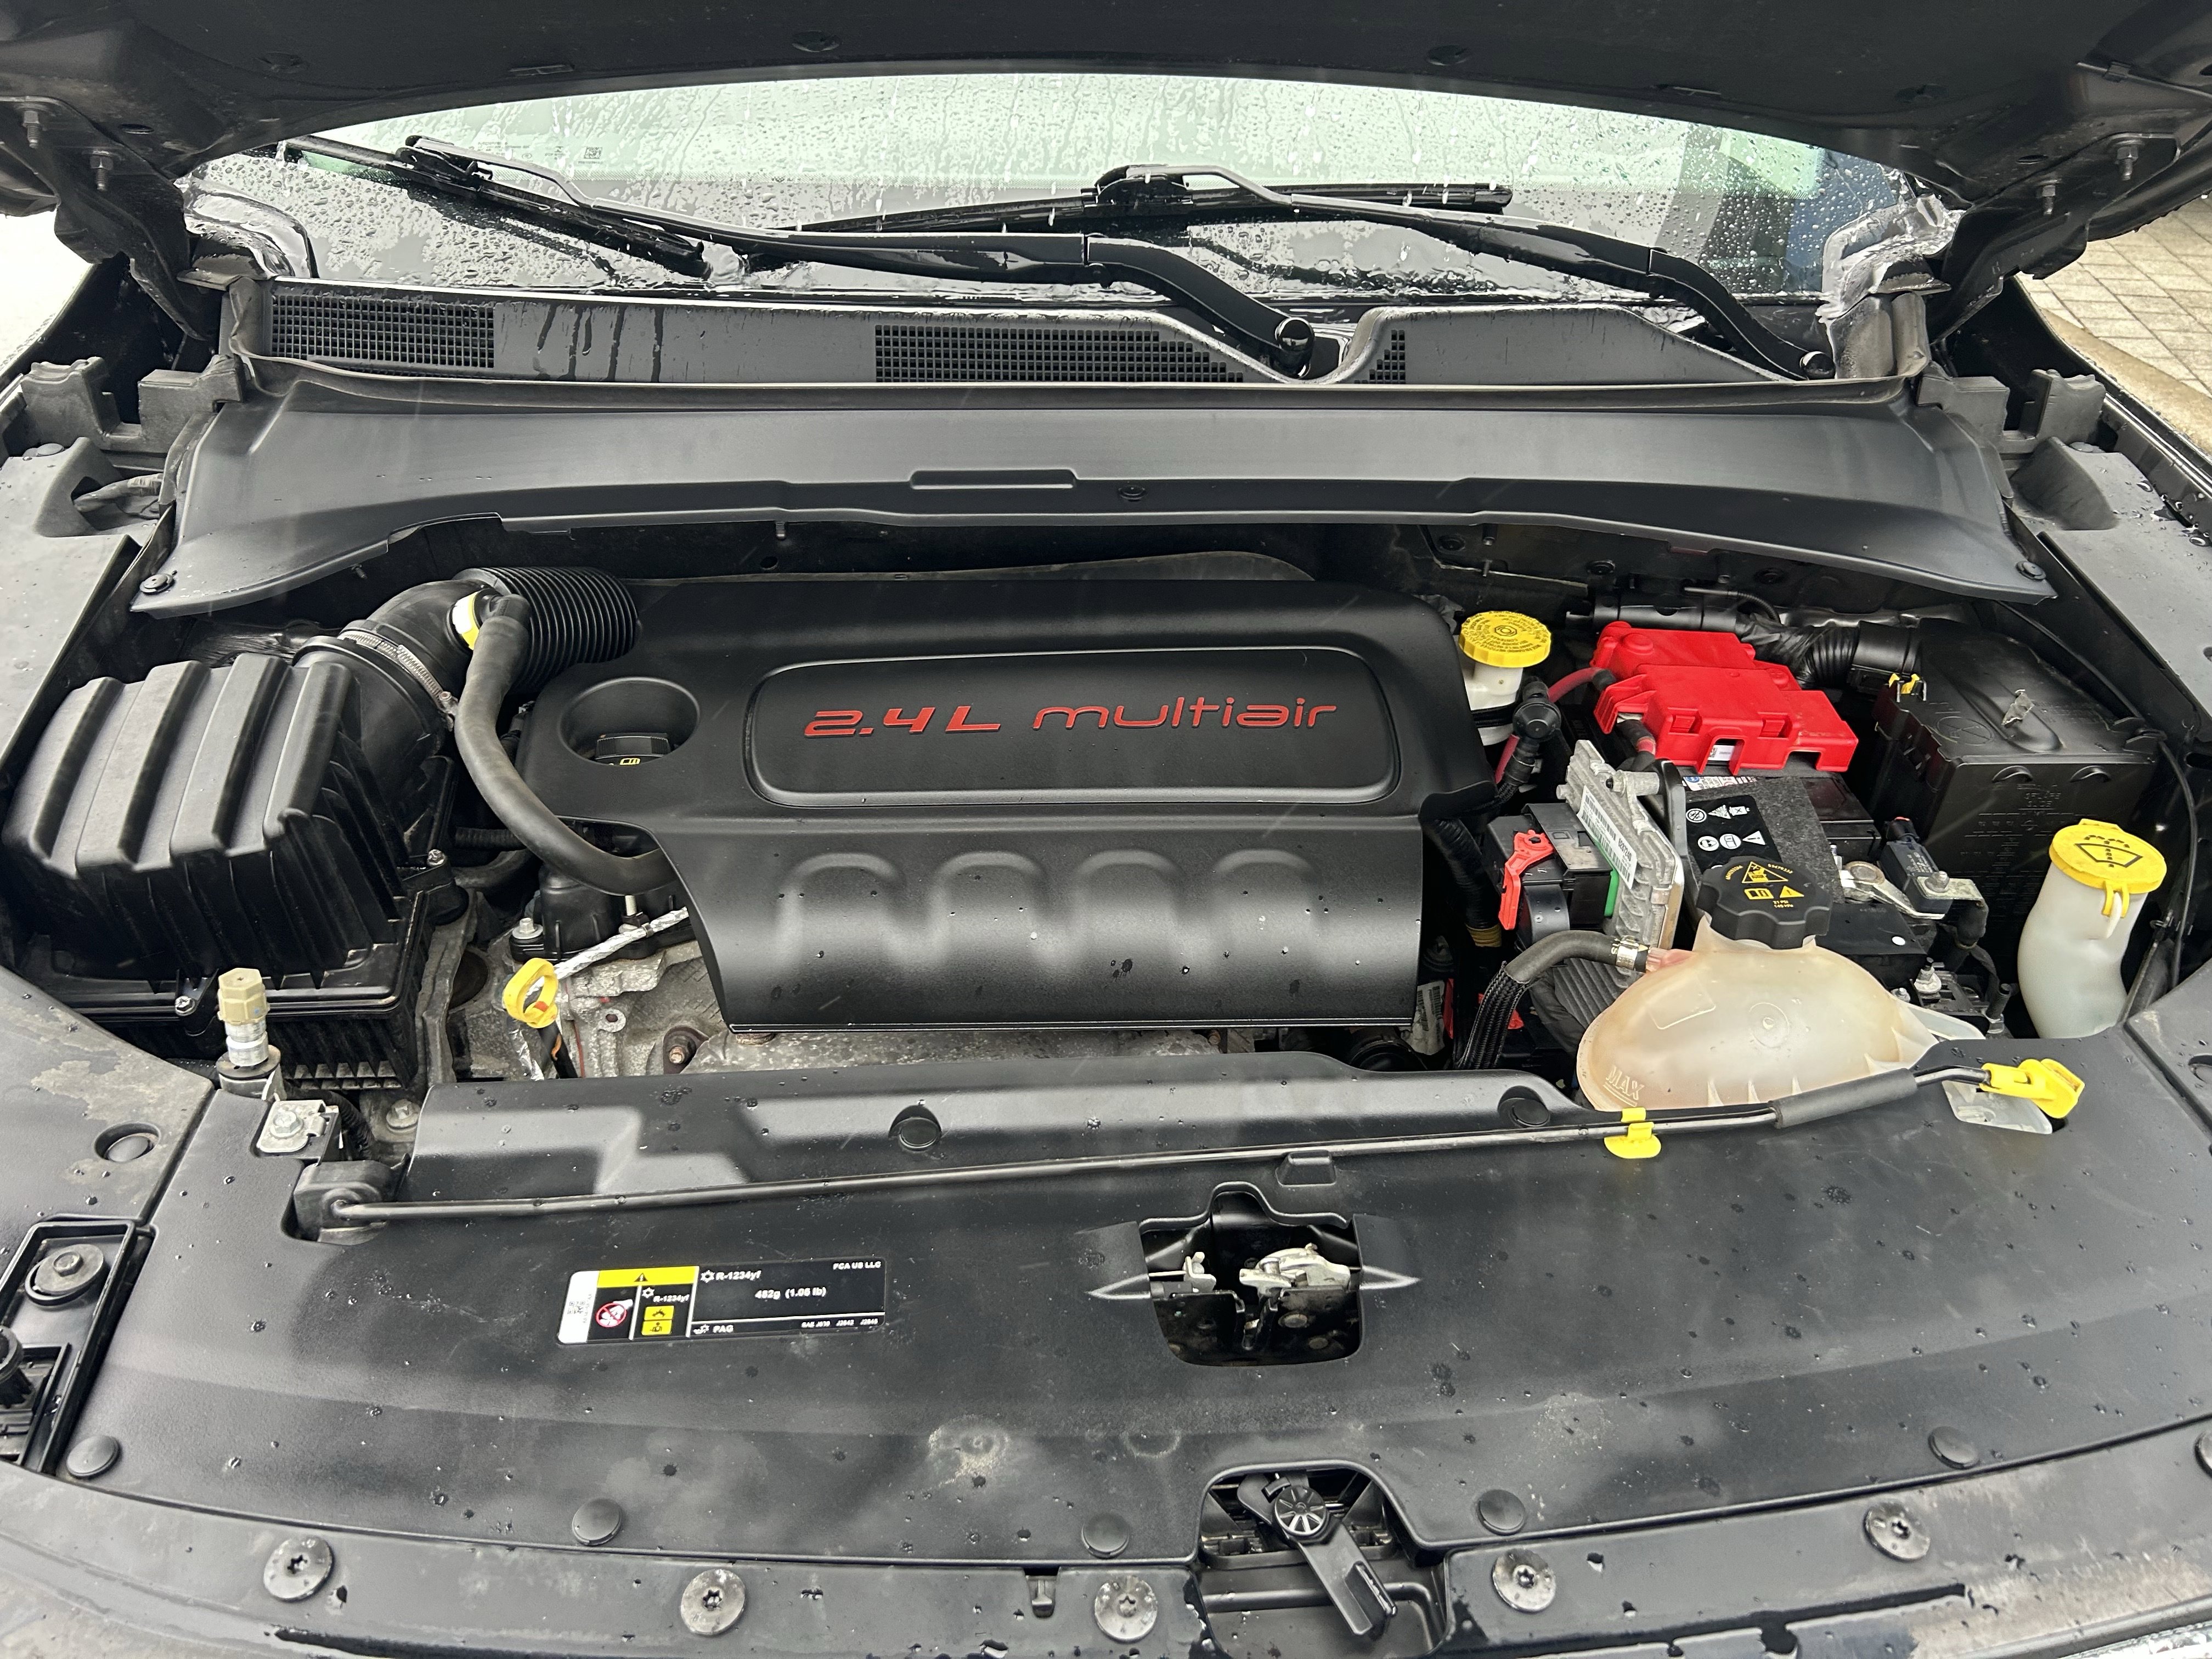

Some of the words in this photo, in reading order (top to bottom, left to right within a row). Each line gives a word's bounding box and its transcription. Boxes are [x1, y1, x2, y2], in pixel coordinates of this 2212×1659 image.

[1031, 697, 1338, 730] multiair
[1605, 1065, 1645, 1101] MAX
[865, 1261, 882, 1269] LLC
[715, 1270, 761, 1282] R-1234yf
[812, 1286, 827, 1297] lb)
[653, 1294, 690, 1302] R-1234yf
[712, 1324, 733, 1333] PAG
